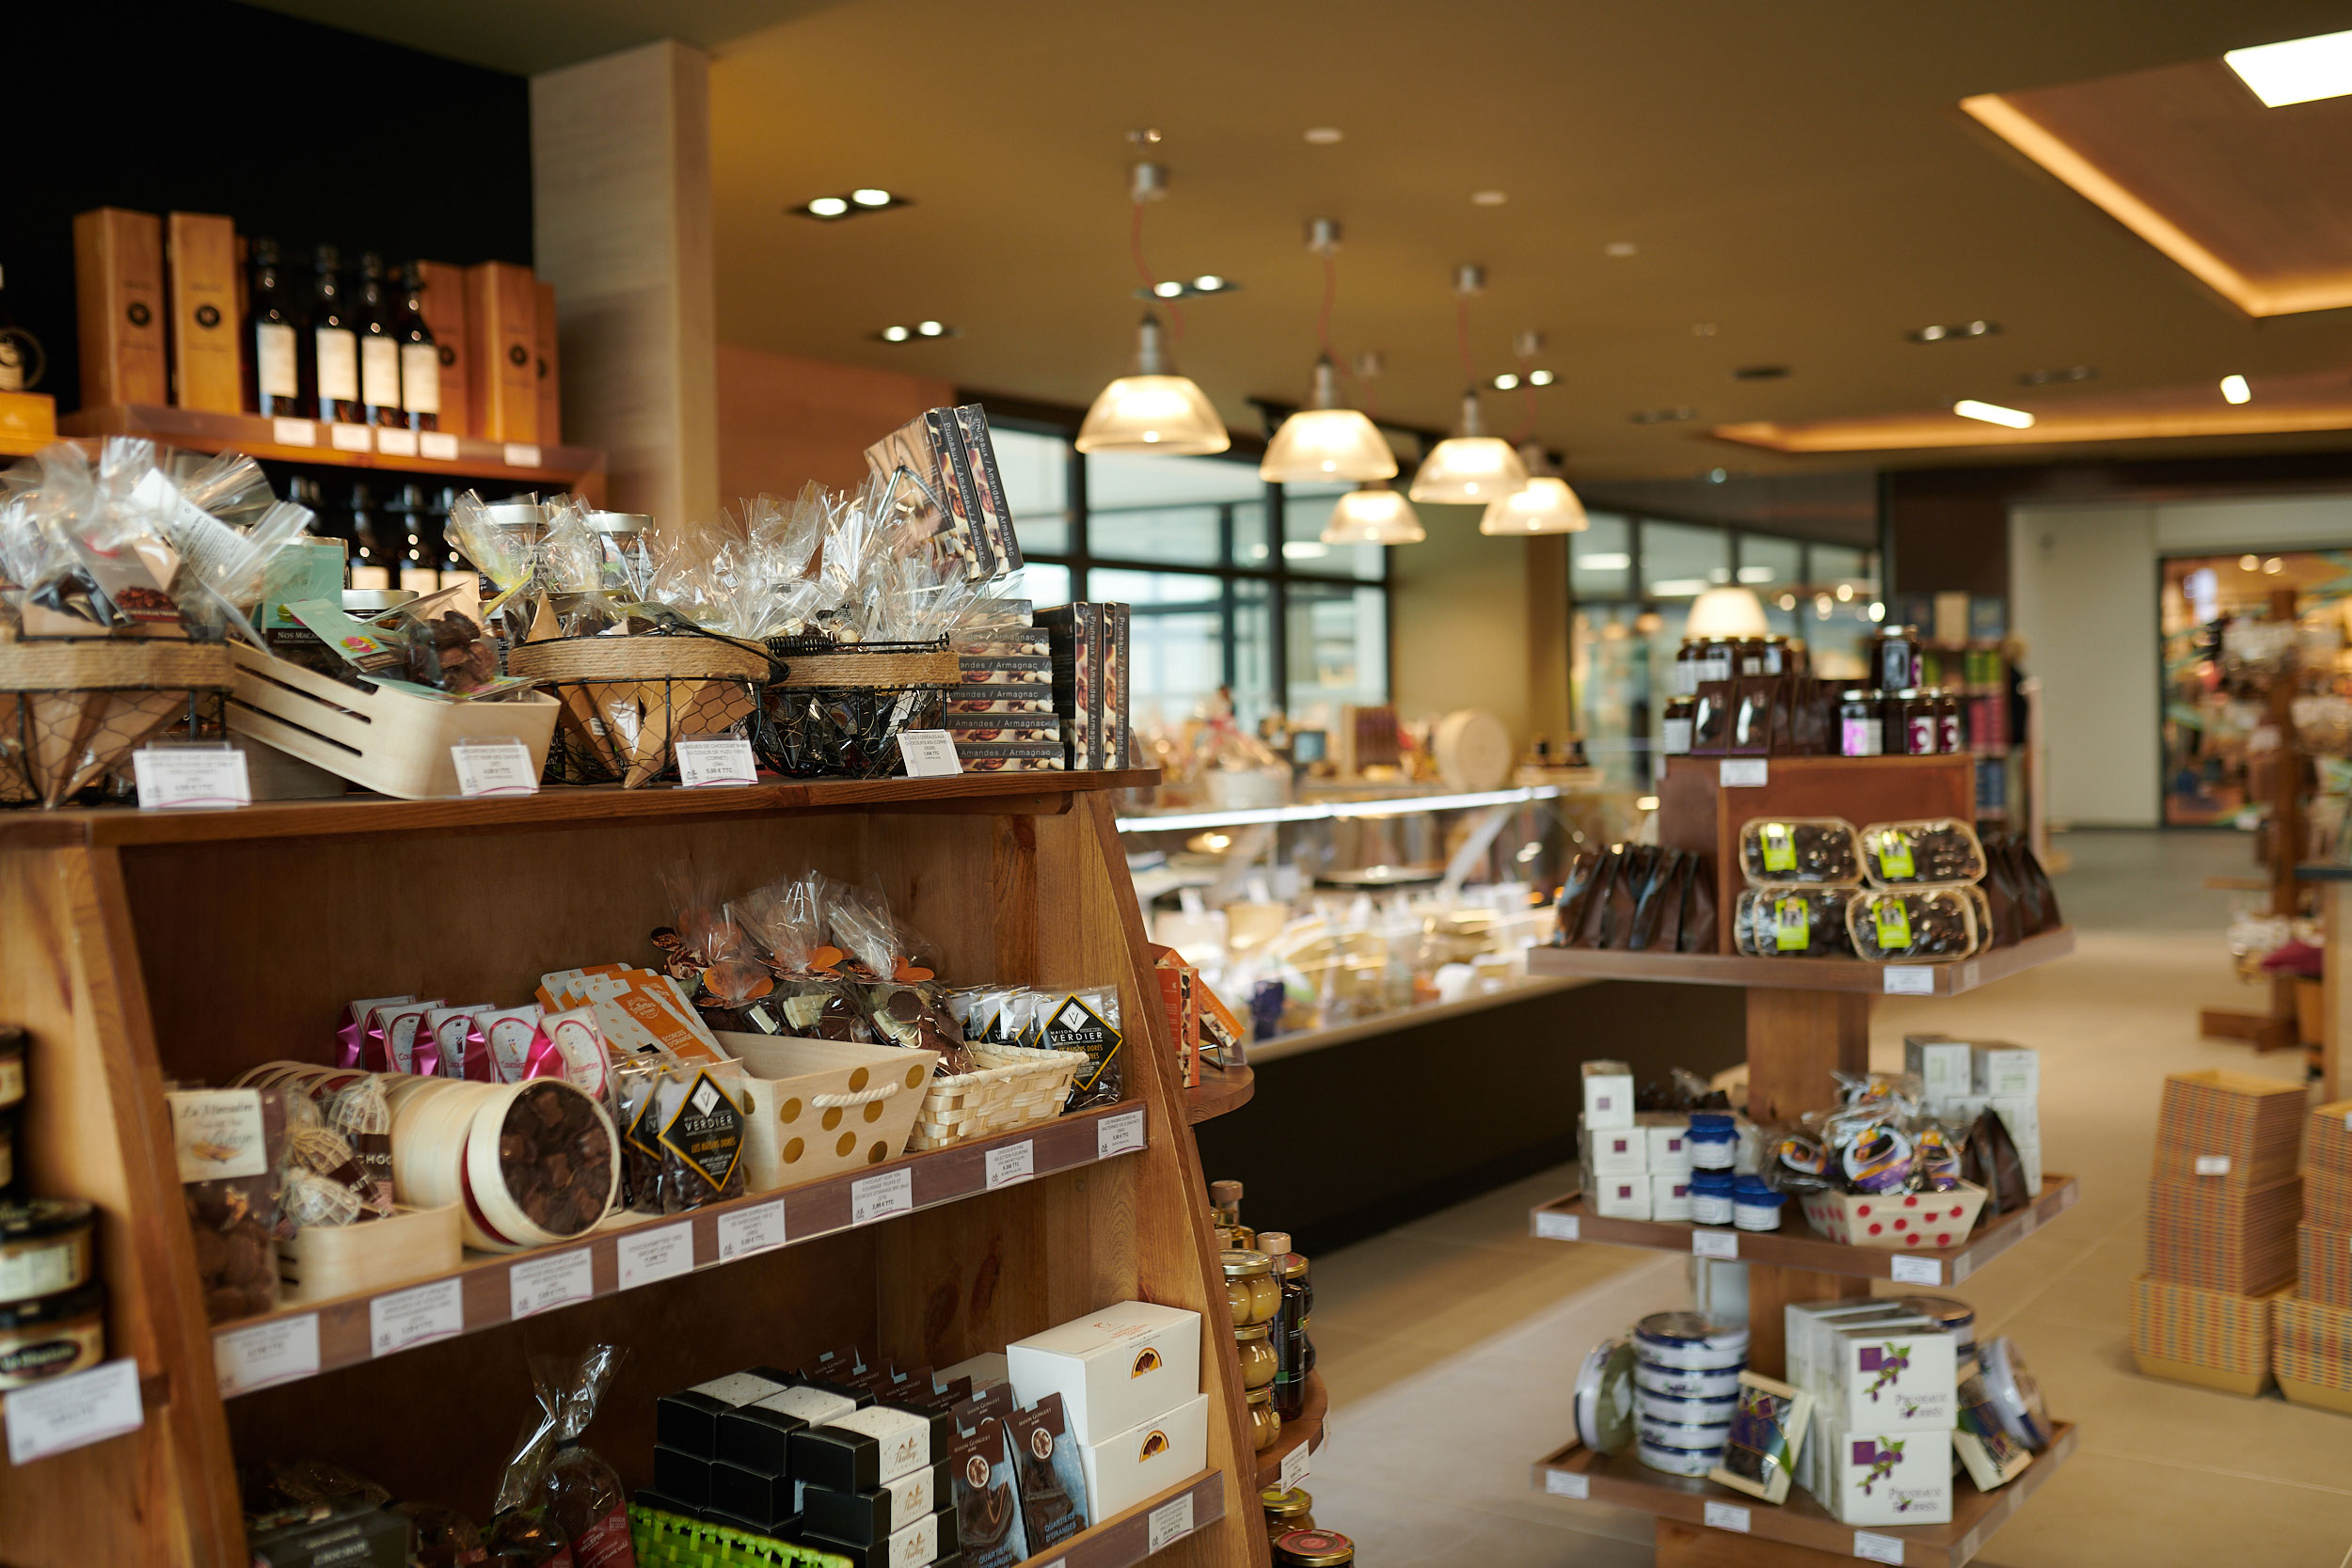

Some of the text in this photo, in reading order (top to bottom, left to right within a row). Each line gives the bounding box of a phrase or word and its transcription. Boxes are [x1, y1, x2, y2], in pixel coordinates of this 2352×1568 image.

[944, 422, 960, 466] Pruneaux
[957, 472, 972, 511] Amandes
[969, 519, 986, 562] Armagnac
[974, 418, 989, 458] Pruneaux
[987, 467, 1001, 506] Amandes
[999, 515, 1015, 557] Armagnac
[996, 662, 1038, 671] Armagnac
[997, 691, 1039, 700] Armagnac
[1010, 749, 1051, 757] Armagnac
[1051, 1032, 1103, 1042] VERDIER
[684, 1115, 734, 1132] VERDIER
[358, 1155, 392, 1165] CHOC
[349, 1175, 370, 1194] AIT
[1045, 1512, 1075, 1532] QUARTIERS
[1046, 1520, 1077, 1543] D'ORANGES
[979, 1542, 1011, 1564] QUARTIERS
